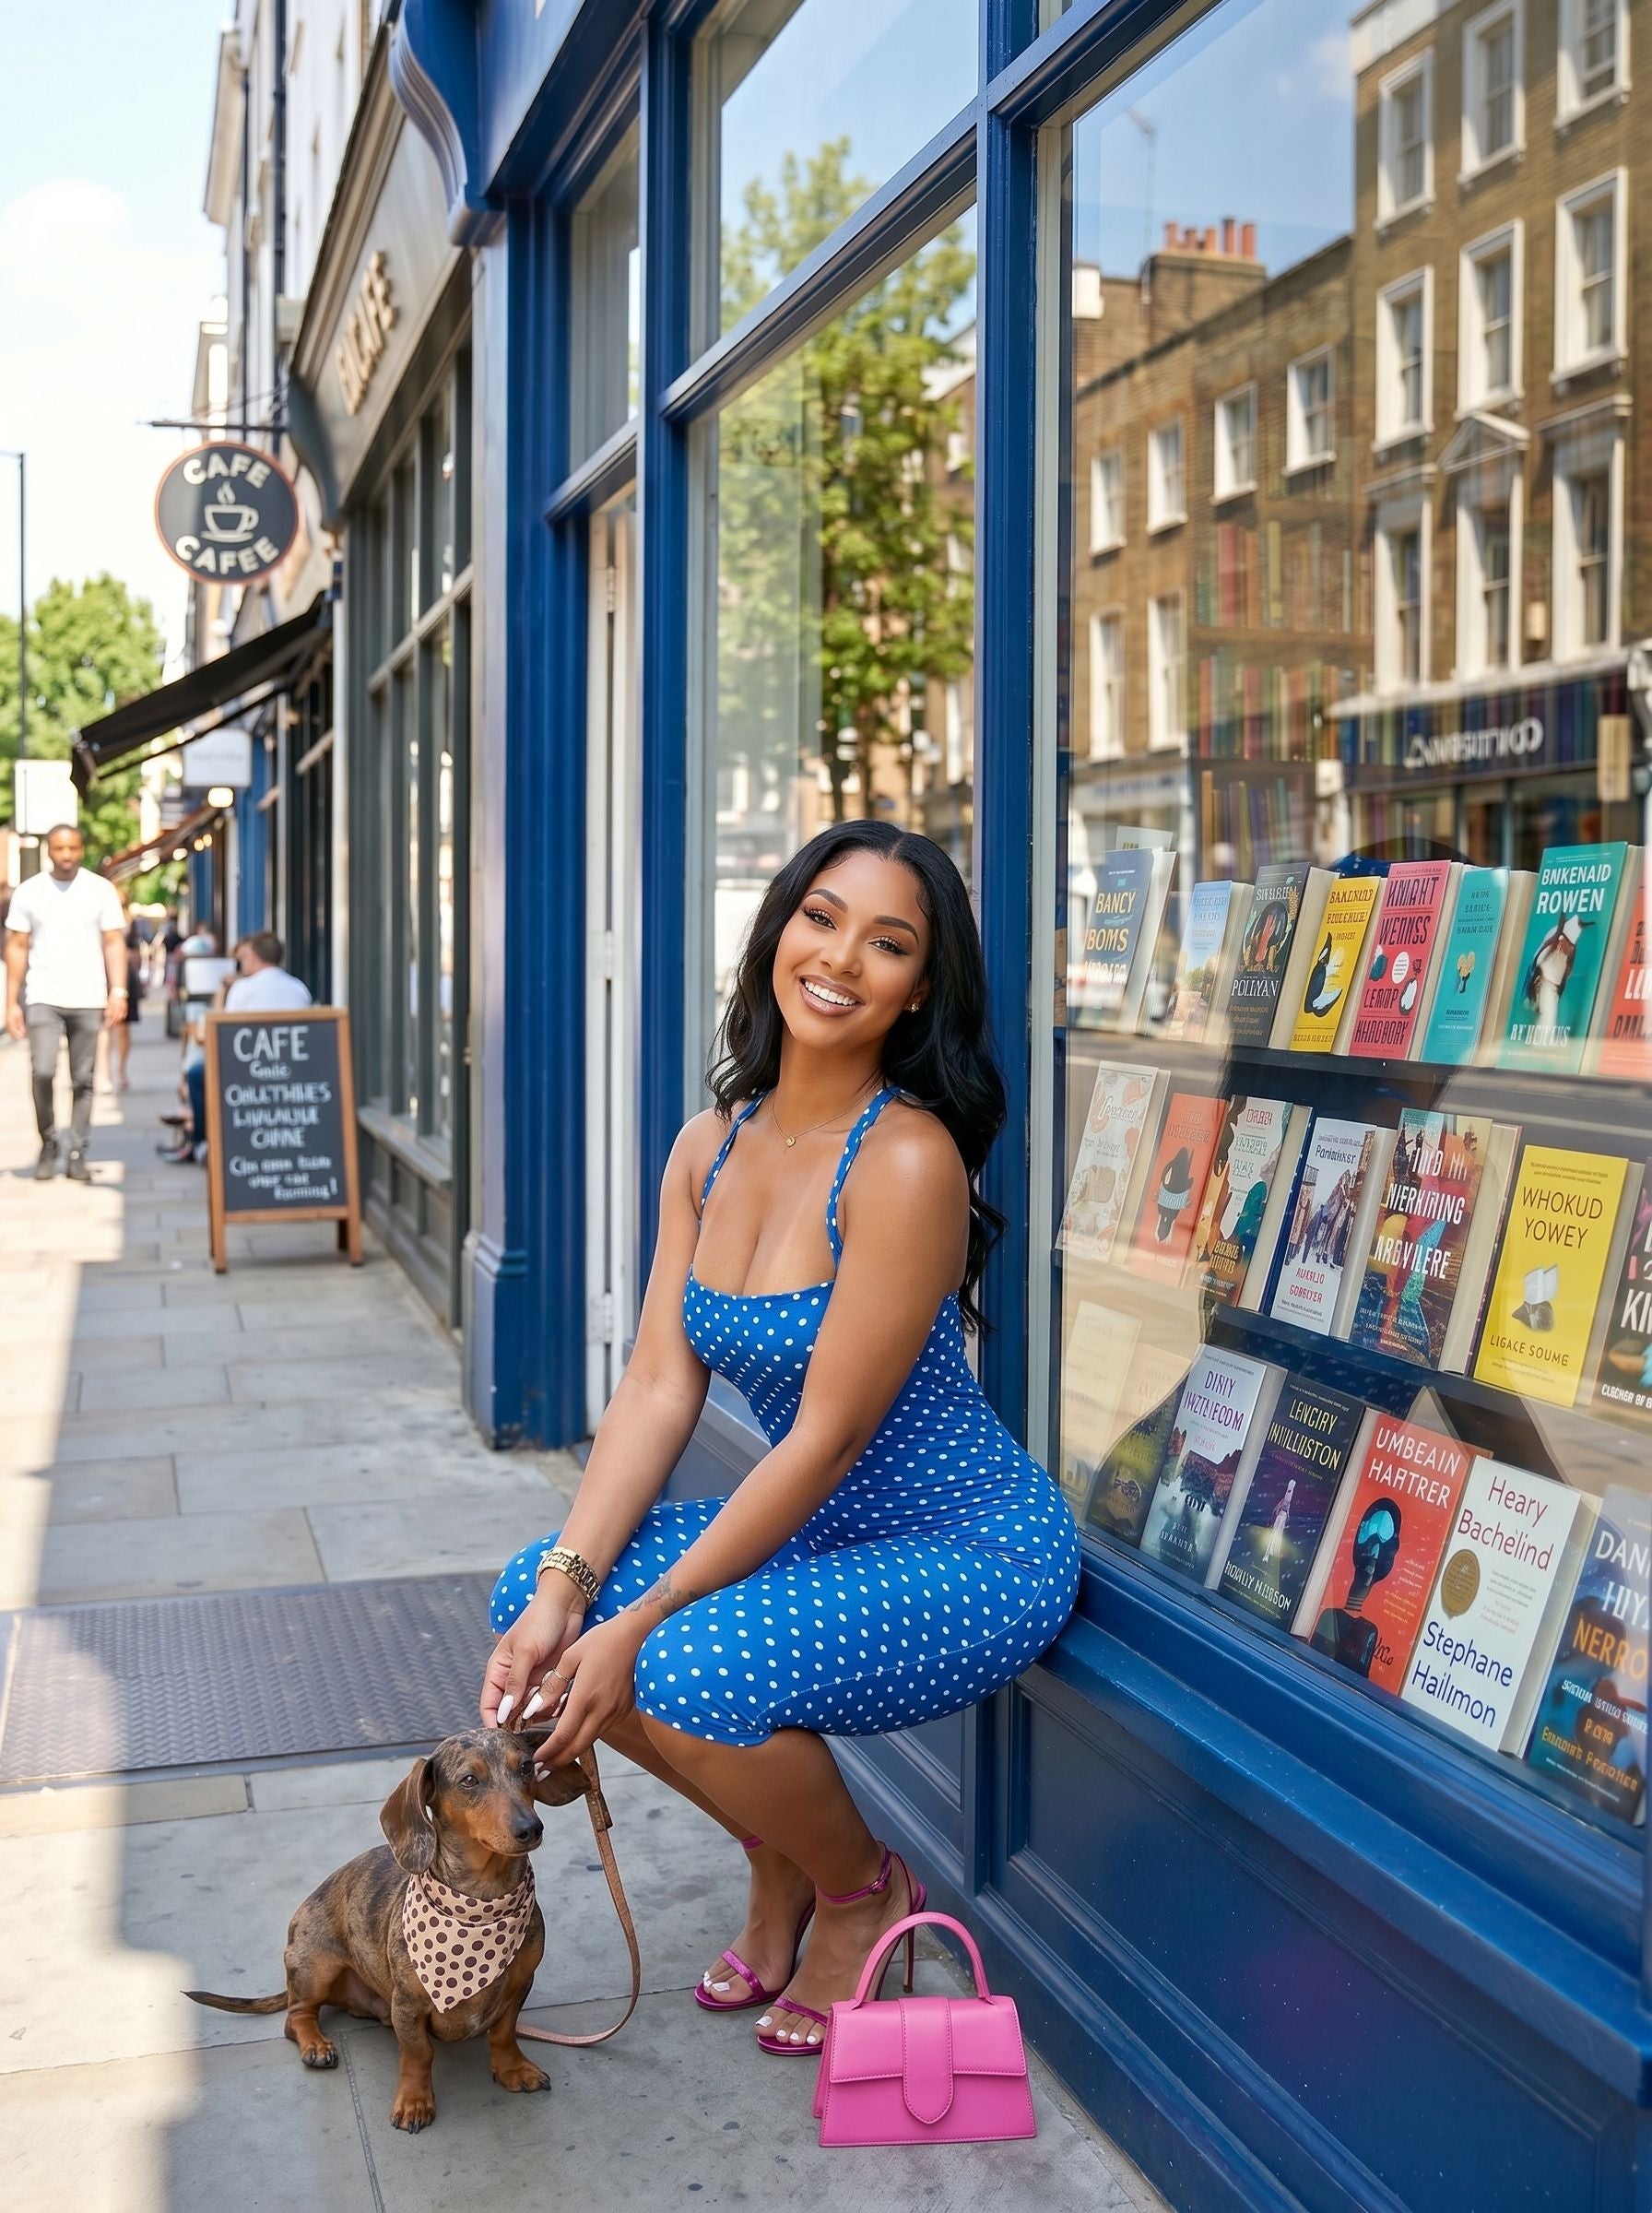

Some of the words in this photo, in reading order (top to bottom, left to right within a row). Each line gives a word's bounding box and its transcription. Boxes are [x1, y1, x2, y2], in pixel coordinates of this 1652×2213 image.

[183, 452, 271, 489] CAFE
[175, 535, 279, 574] CAFEE
[1095, 891, 1136, 914] BANCY
[1536, 888, 1605, 915] ROWEN
[233, 1025, 310, 1062] CAFE
[1522, 1186, 1603, 1219] WHOKUD
[1525, 1217, 1588, 1249] YOWEY
[1488, 1475, 1549, 1528] Heary
[1422, 1621, 1513, 1686] Stephane
